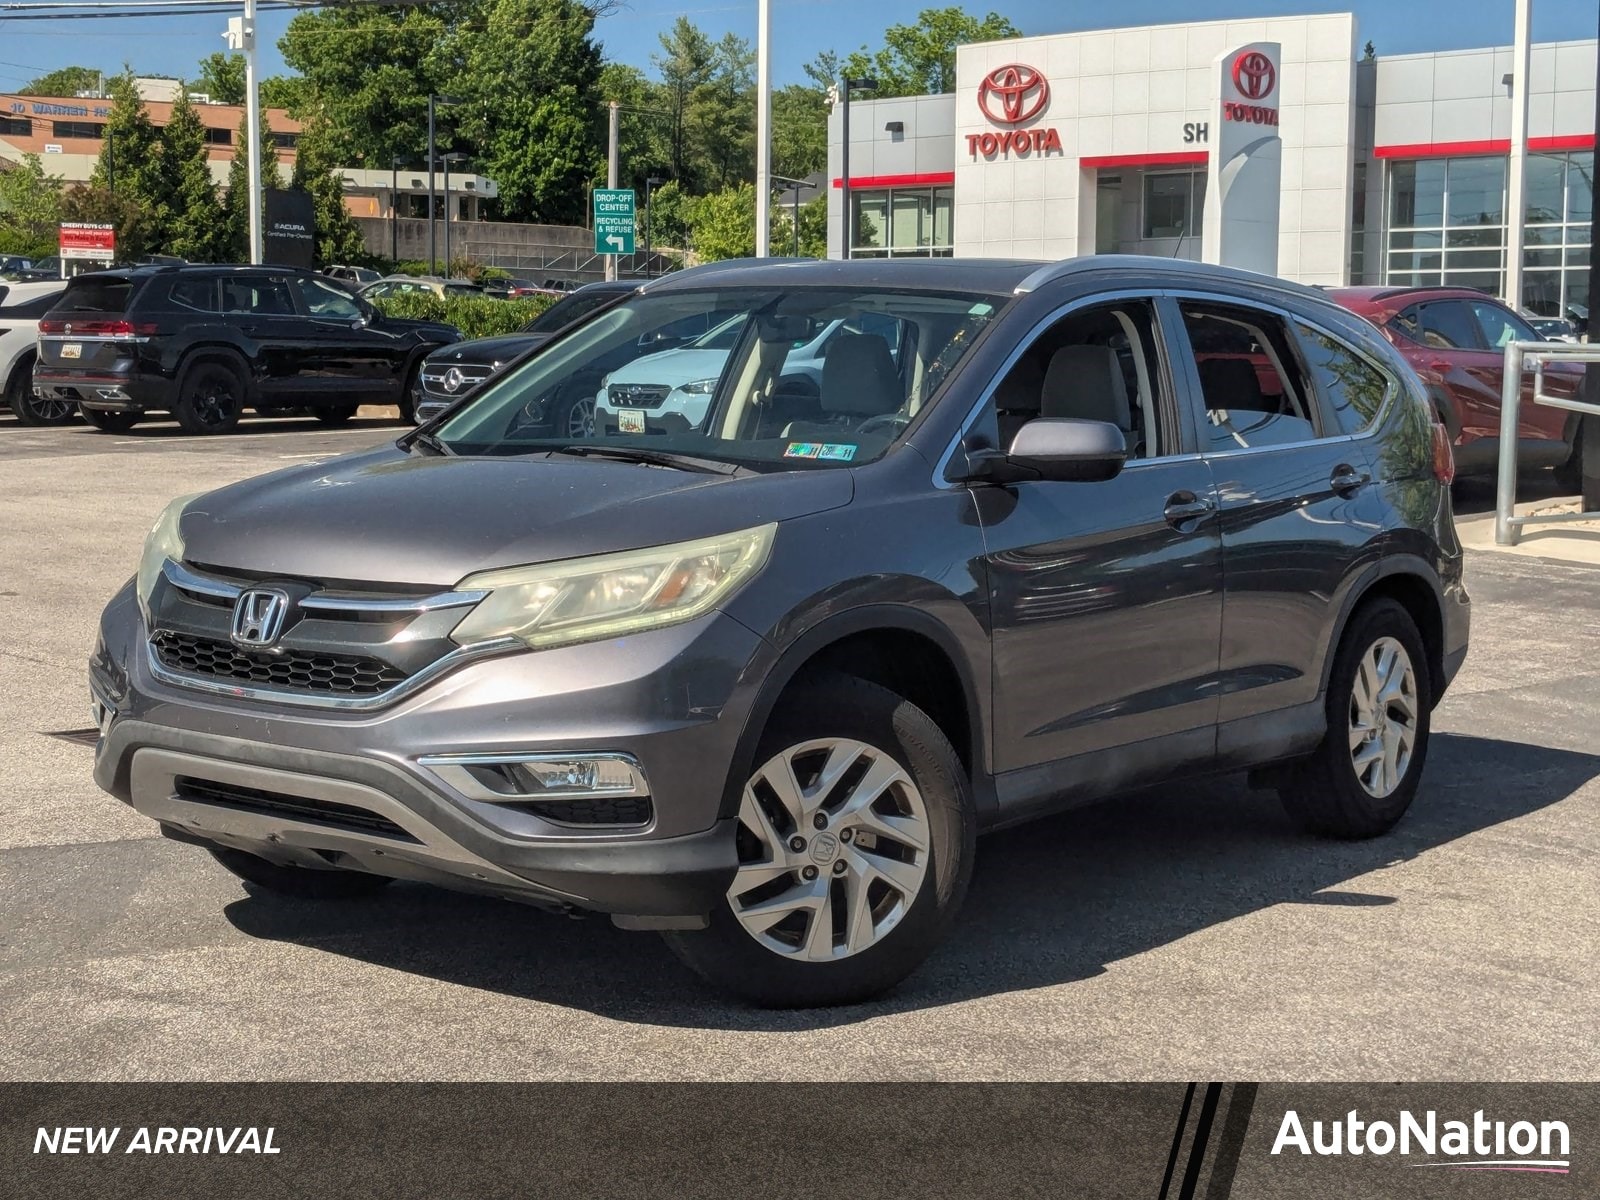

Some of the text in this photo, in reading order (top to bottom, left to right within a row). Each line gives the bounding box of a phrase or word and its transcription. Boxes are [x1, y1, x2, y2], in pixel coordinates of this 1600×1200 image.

[32, 103, 88, 116] WARREN
[1223, 102, 1279, 127] TOYOTA
[1183, 122, 1209, 143] SH
[965, 128, 1062, 156] TOYOTA
[596, 194, 633, 202] DROP-OFF
[599, 203, 630, 211] CENTER
[596, 217, 633, 225] RECYCLING
[280, 223, 305, 231] ACURA
[598, 225, 633, 233] & REFUSE
